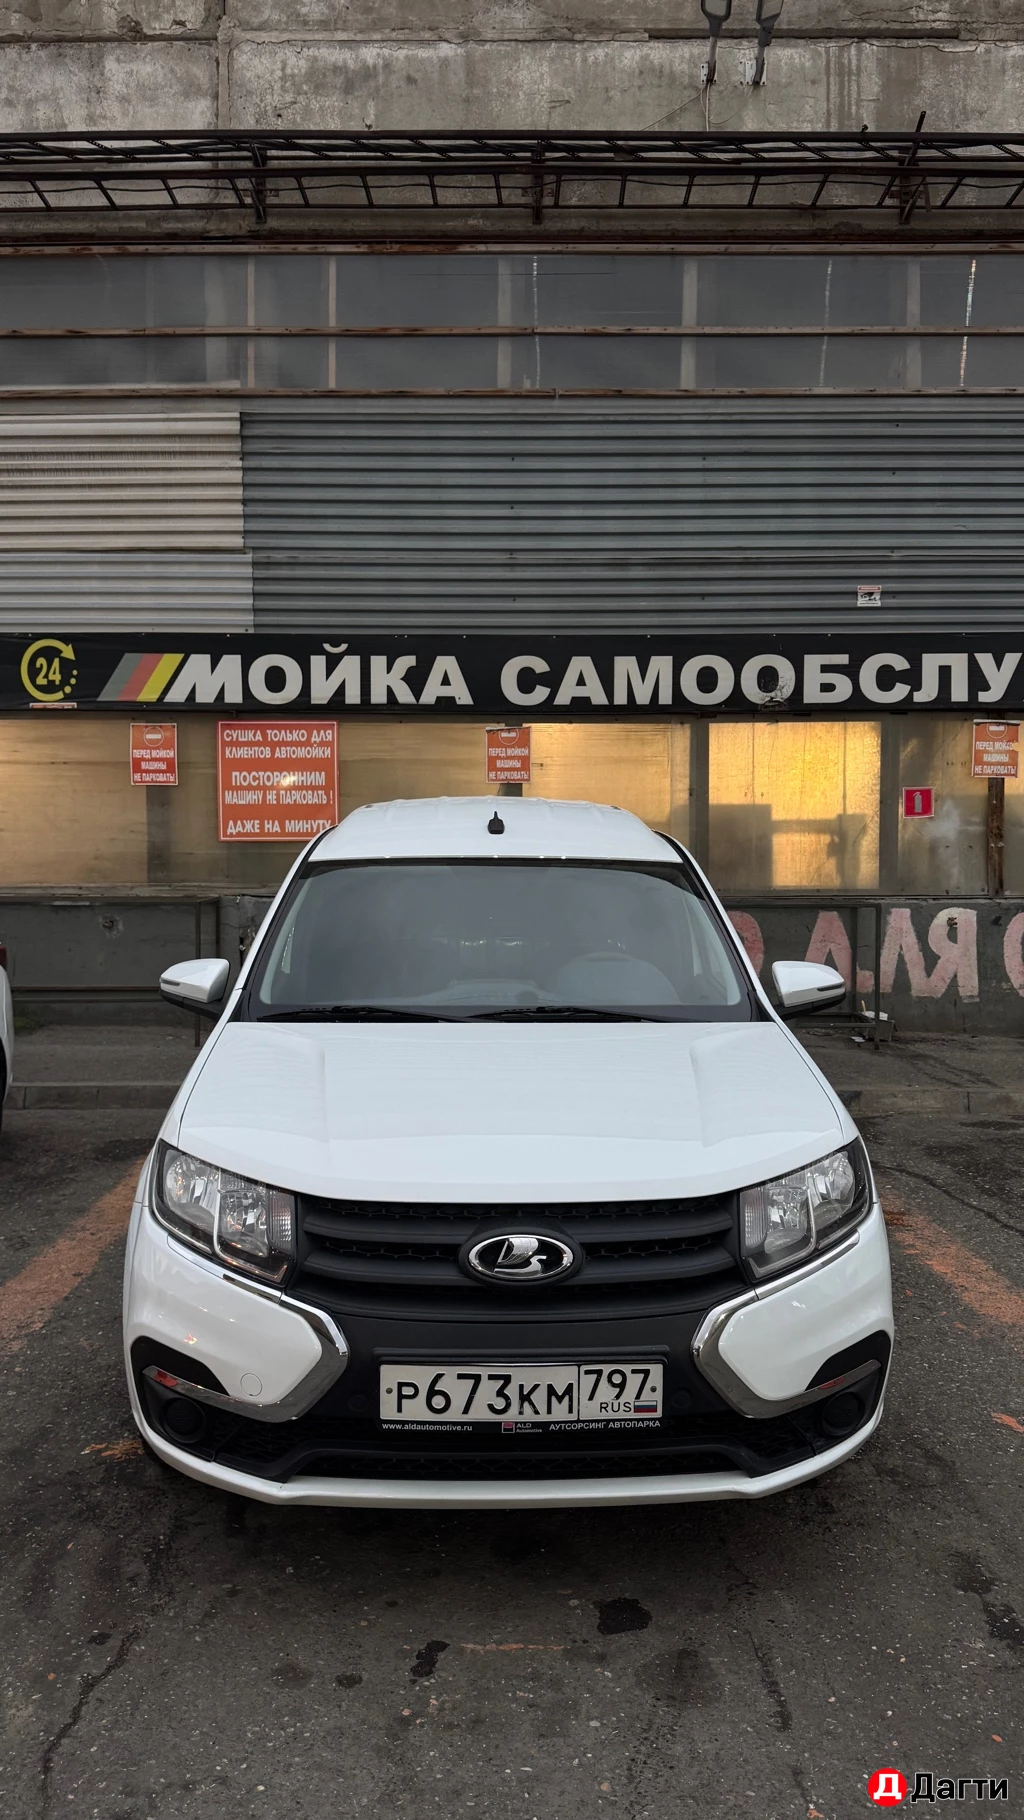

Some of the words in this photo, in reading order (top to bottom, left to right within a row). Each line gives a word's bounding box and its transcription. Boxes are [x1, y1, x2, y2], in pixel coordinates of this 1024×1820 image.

[36, 657, 61, 685] 24
[164, 643, 474, 705] МОЙКА
[223, 729, 263, 741] СУШКА
[266, 729, 307, 741] ТОЛЬКО
[311, 729, 333, 743] ДЛЯ
[225, 746, 271, 758] КЛИЕНТОВ
[274, 744, 331, 758] АВТОМОЙКИ
[489, 747, 506, 757] ПЕРЕД
[507, 746, 529, 756] МОЙКОЙ
[976, 741, 993, 751] ПЕРЕД
[133, 749, 151, 759] ПЕРЕД
[152, 747, 174, 758] МОЙКОЙ
[983, 753, 1009, 762] МАШИНЫ
[141, 760, 167, 770] МАШИНЫ
[496, 759, 522, 768] МАШИНЫ
[974, 765, 982, 774] НЕ
[134, 773, 141, 781] НЕ
[231, 771, 326, 786] ПОСТОРОННИМ
[489, 771, 496, 780] НЕ
[225, 790, 263, 804] МАШИНУ
[266, 790, 277, 804] НЕ
[227, 820, 260, 835] ДАЖЕ
[264, 820, 281, 833] НА
[583, 1368, 651, 1402] 797
[599, 1401, 632, 1413] RUS
[381, 1423, 473, 1431] www.aldautomotive.ru
[549, 1422, 606, 1431] АУТСОРСИНГ
[607, 1420, 661, 1429] АВТОПАРКА
